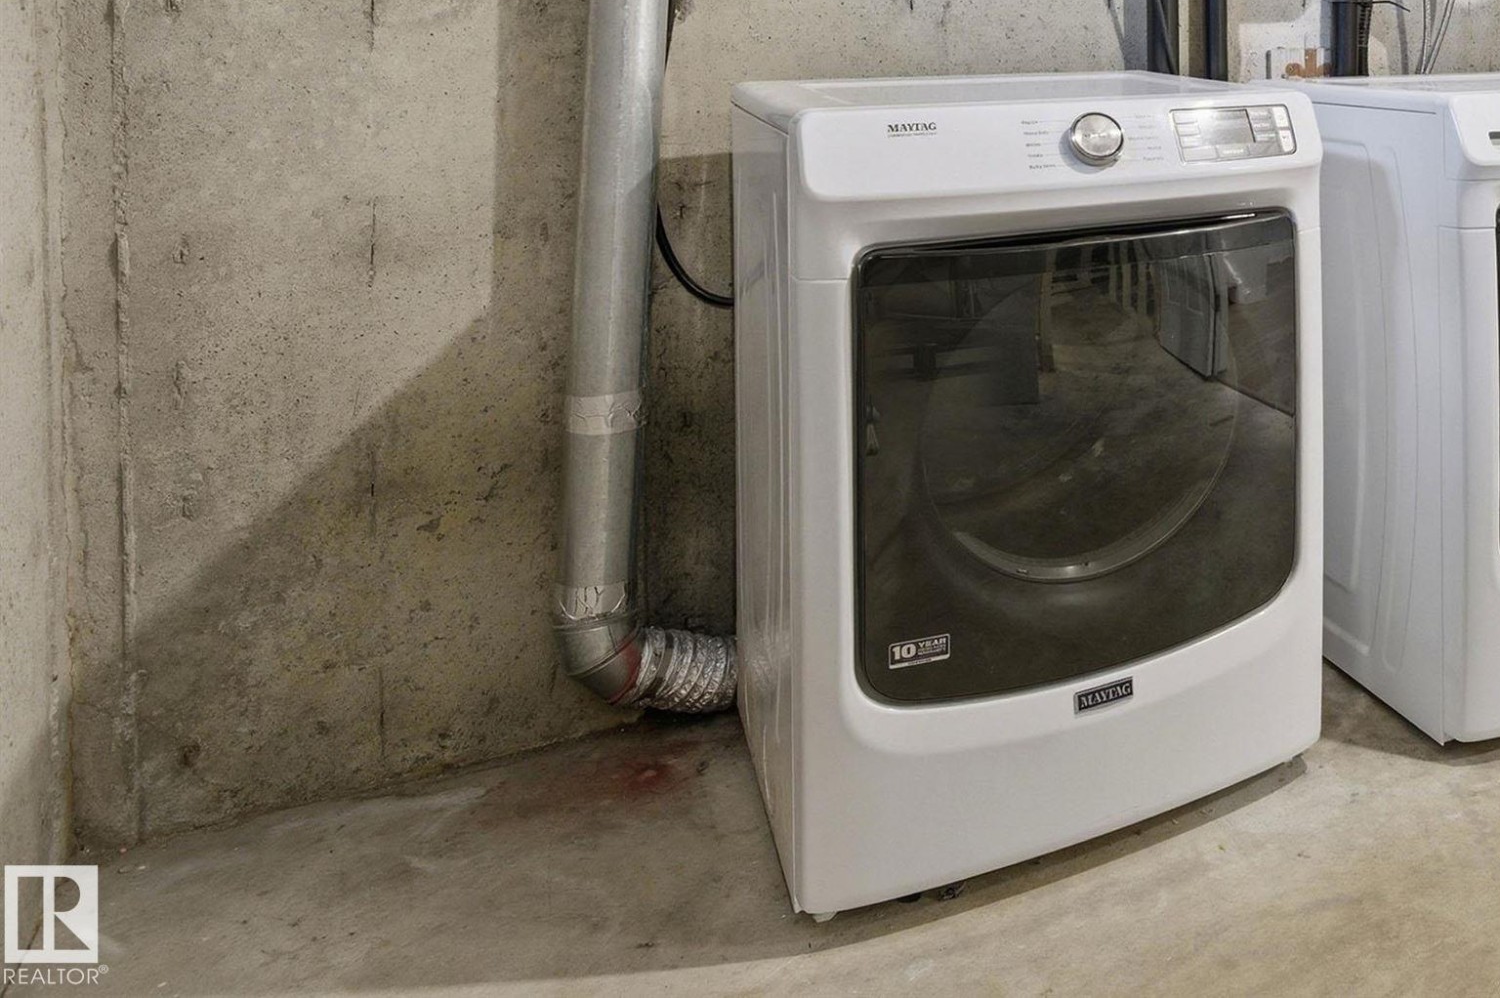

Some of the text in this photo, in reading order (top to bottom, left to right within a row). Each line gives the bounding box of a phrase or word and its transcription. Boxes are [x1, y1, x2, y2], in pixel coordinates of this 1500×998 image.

[887, 121, 937, 133] MAYTAG
[892, 643, 917, 660] 10
[1079, 683, 1131, 708] MAYTAG
